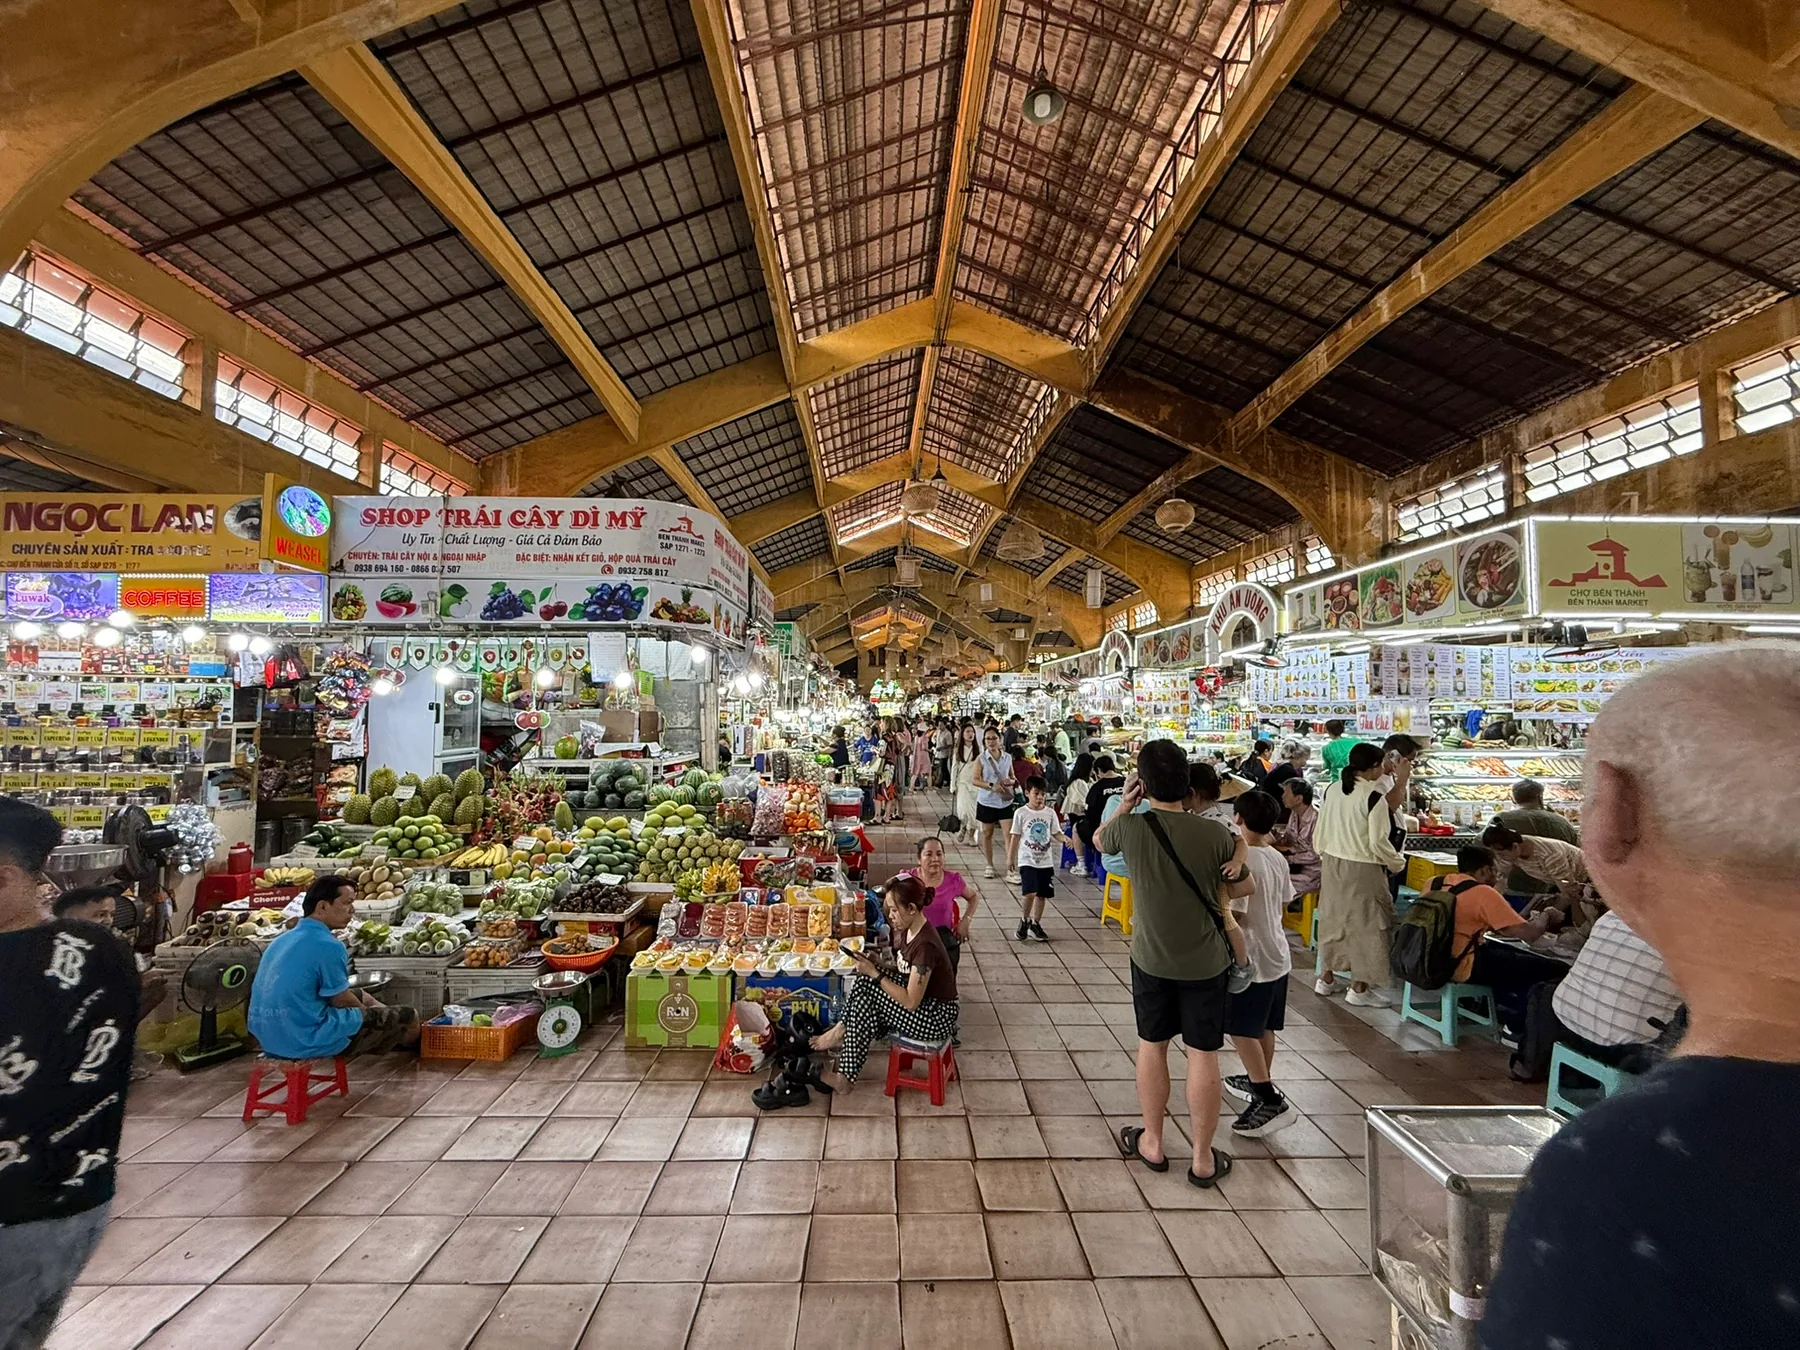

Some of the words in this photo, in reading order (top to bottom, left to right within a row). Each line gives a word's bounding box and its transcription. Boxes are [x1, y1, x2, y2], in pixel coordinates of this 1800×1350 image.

[3, 501, 125, 539] NGỌC
[131, 503, 217, 534] LAN
[360, 507, 431, 527] SHOP
[436, 504, 502, 529] TRÁI
[507, 504, 565, 529] CÂY
[569, 505, 600, 529] DÌ
[605, 505, 648, 530] MỸ
[402, 533, 417, 545] Uy
[445, 531, 470, 545] Chất
[473, 533, 505, 547] Lượng
[516, 533, 533, 546] Giá
[12, 541, 60, 555] CHUYÊN
[63, 541, 88, 556] SẢN
[91, 540, 124, 556] XUẤT
[275, 535, 323, 567] WEASEL
[348, 550, 380, 561] CHUYÊN:
[382, 551, 398, 561] TRÁI
[400, 551, 415, 561] CÂY
[417, 551, 431, 563] NỘI
[516, 553, 531, 563] ĐẶC
[533, 552, 551, 563] BIỆT:
[576, 551, 590, 562] KẾT
[662, 555, 677, 566] CÂY
[354, 563, 373, 573] 0938
[447, 565, 461, 574] 507
[618, 567, 636, 575] 0932
[638, 567, 653, 576] 758
[655, 568, 669, 577] 817
[15, 592, 51, 603] Luwak
[122, 589, 205, 609] COFFEE
[1570, 588, 1591, 597] CHỢ
[1593, 587, 1612, 597] BẾN
[1614, 587, 1646, 597] THÀNH
[1616, 599, 1648, 607] MARKET
[1211, 601, 1228, 635] KHU
[253, 895, 291, 904] Cherries
